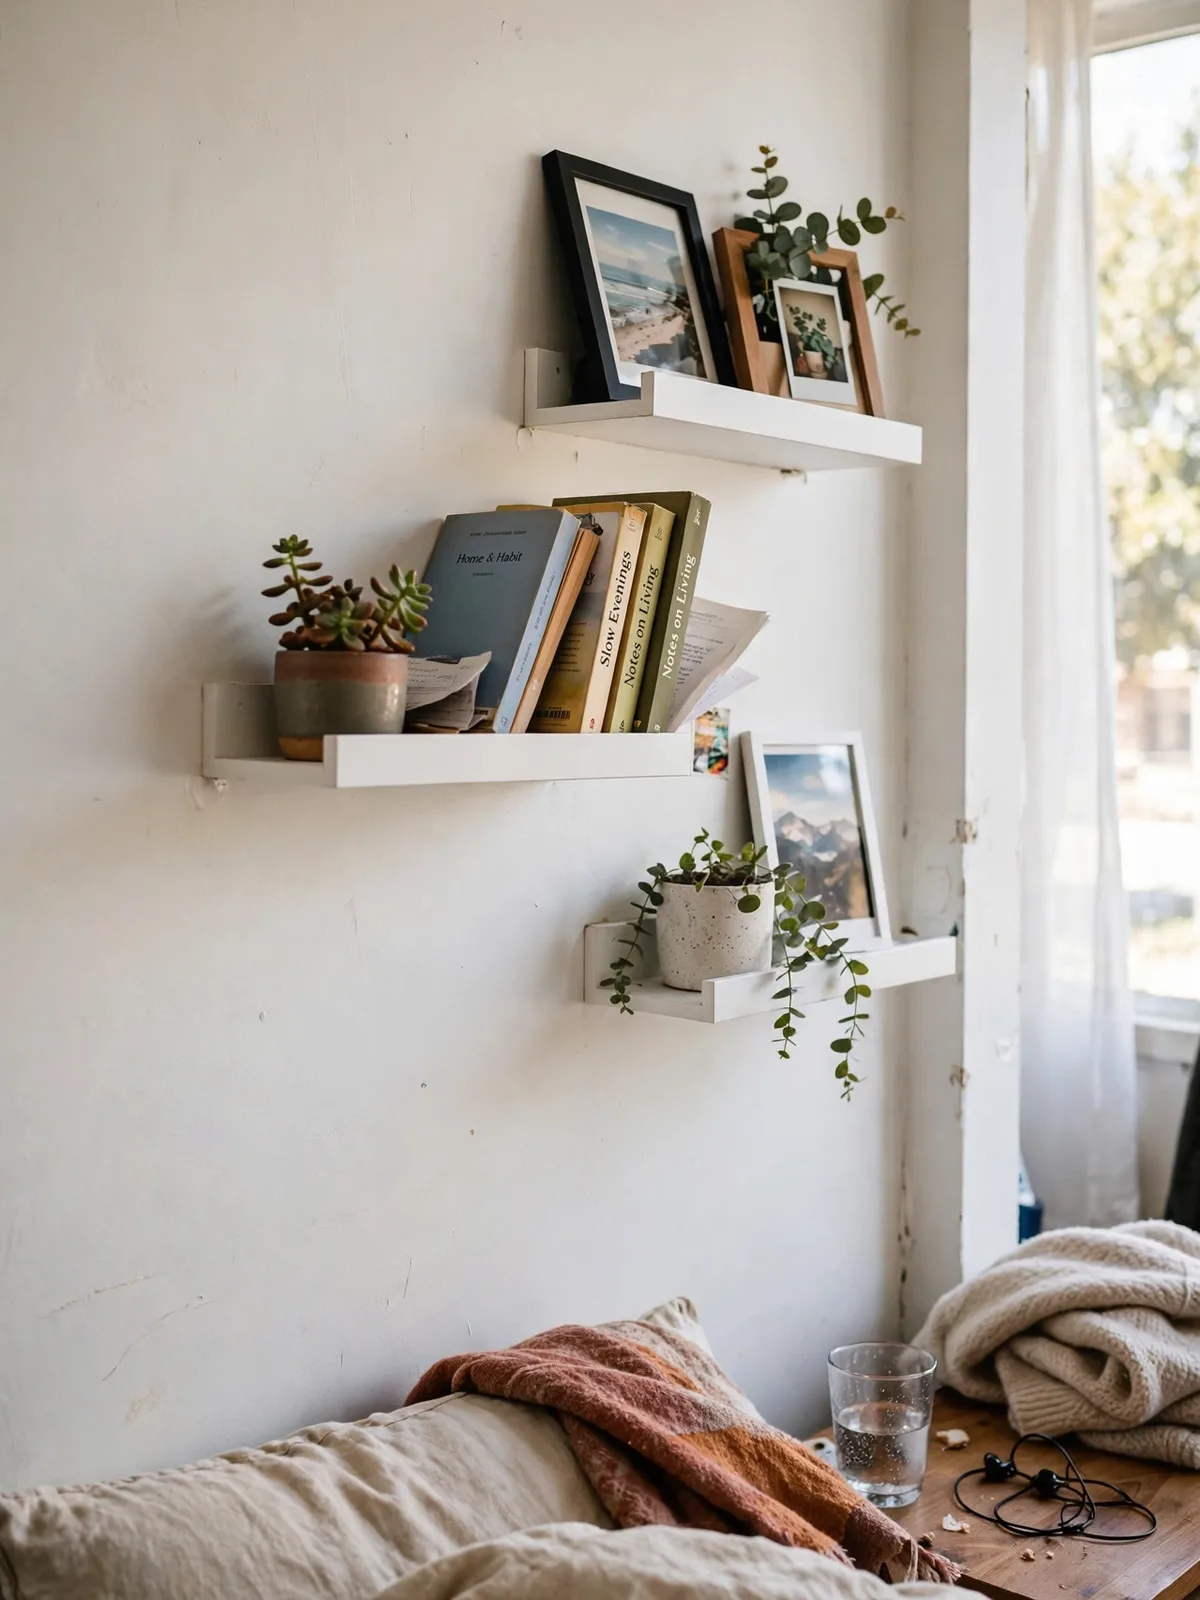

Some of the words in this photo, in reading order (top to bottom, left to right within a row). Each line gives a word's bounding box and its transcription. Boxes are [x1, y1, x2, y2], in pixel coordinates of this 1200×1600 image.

[456, 552, 485, 564] Home
[486, 552, 494, 563] &
[496, 551, 523, 563] Habit
[676, 553, 697, 605] Living
[600, 627, 616, 667] Slow
[608, 550, 632, 624] Evenings
[639, 564, 660, 616] Living
[636, 618, 646, 639] on
[674, 609, 684, 629] on
[624, 642, 642, 688] Notes
[662, 633, 679, 679] Notes
